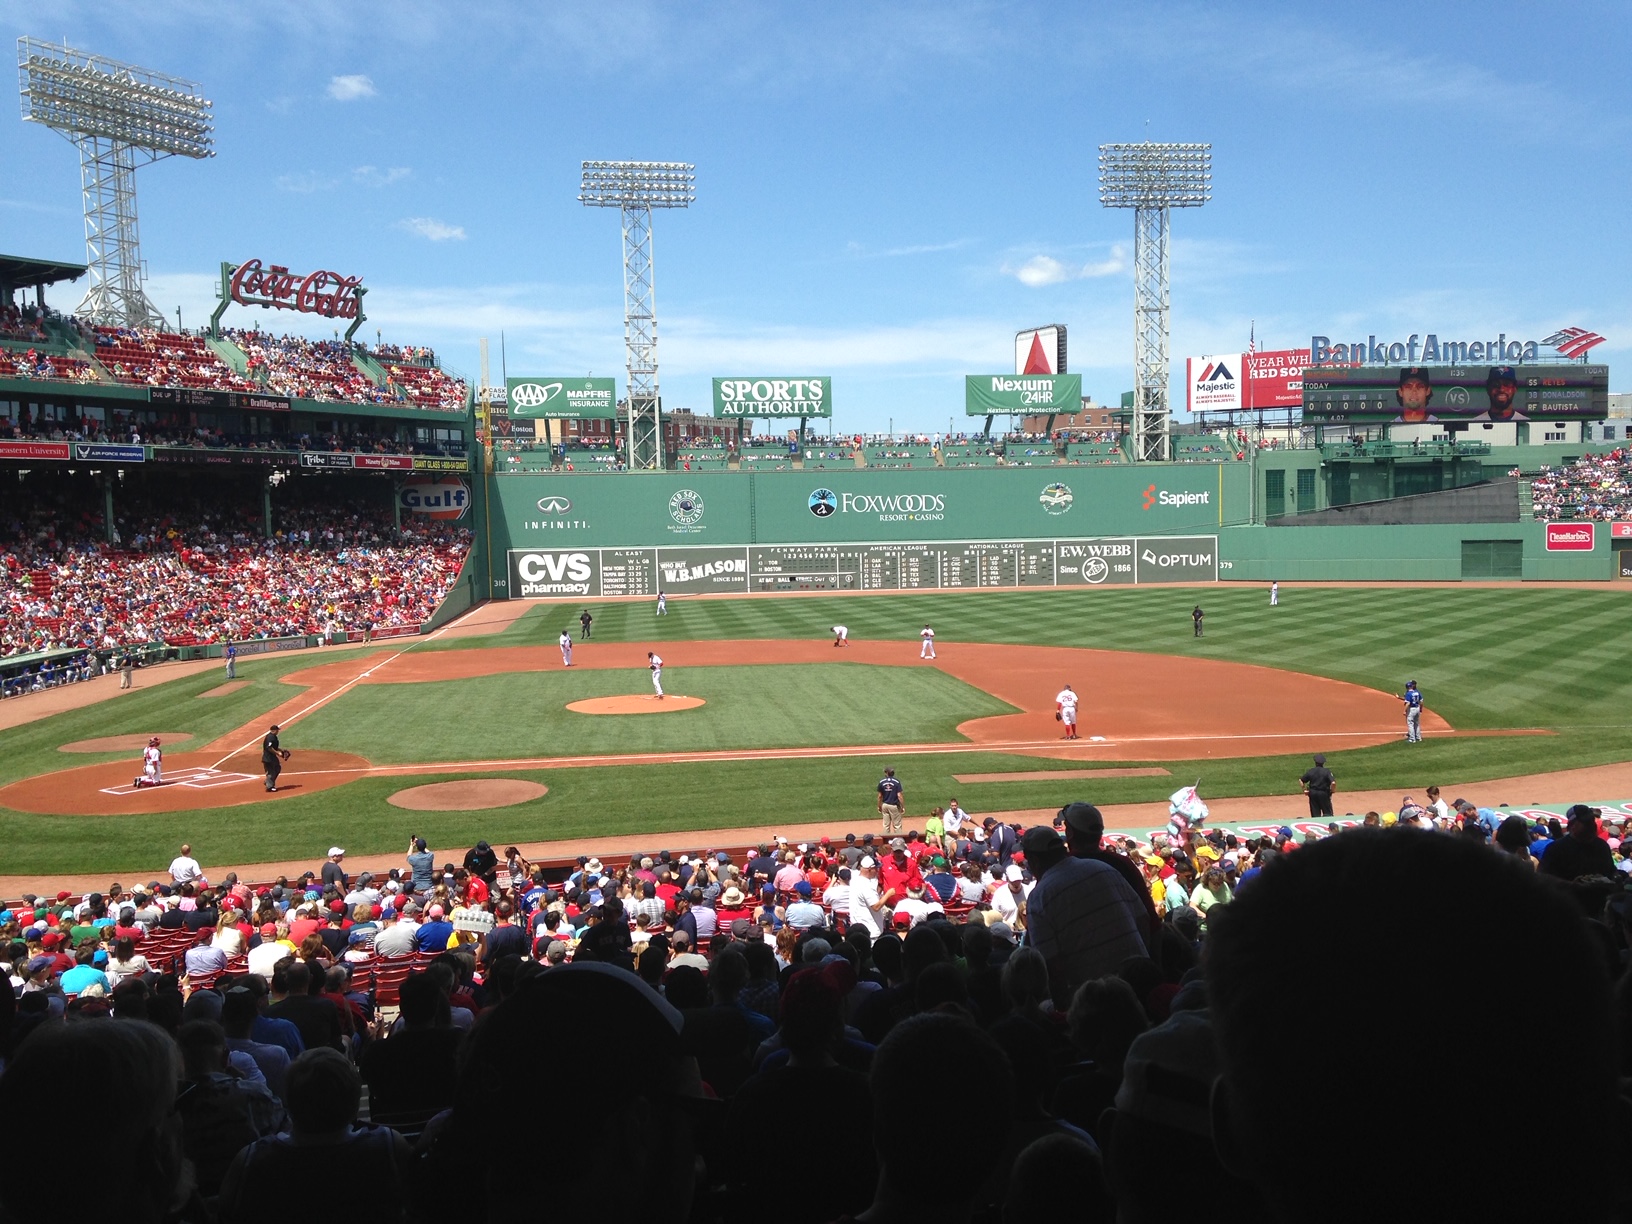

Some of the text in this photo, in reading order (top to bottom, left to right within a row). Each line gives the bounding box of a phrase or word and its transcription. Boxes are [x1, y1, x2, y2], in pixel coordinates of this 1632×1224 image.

[231, 258, 363, 319] Coca-Cola
[1311, 334, 1539, 363] Bank of America
[1247, 356, 1284, 369] WEAR
[1249, 368, 1278, 380] RED
[992, 377, 1053, 391] Nexium
[1197, 381, 1236, 394] Majestic
[1305, 382, 1329, 390] TODAY
[1543, 378, 1566, 386] REYES
[515, 385, 546, 406] AAA
[567, 390, 611, 399] MAPFRE
[720, 380, 824, 401] SPORTS
[1542, 391, 1586, 399] DONALDSON
[250, 398, 289, 410] DraftKings.com
[1450, 393, 1465, 405] VS
[722, 401, 823, 415] AUTHORITY
[1528, 403, 1579, 411] RF BAUTISTA
[30, 447, 66, 457] University
[304, 454, 326, 466] Tribe
[366, 457, 381, 466] Ninety
[415, 460, 427, 469] GIANT
[427, 460, 441, 469] GLASS
[400, 488, 465, 507] Gulf
[671, 491, 698, 507] RED SOX
[842, 493, 945, 513] FOXWOODS
[1159, 490, 1209, 508] Sapient
[914, 513, 944, 521] CASINO
[524, 520, 587, 530] INFINITI
[1060, 544, 1132, 557] F.W. WEBB
[1158, 553, 1212, 567] OPTUM
[1219, 561, 1233, 569] 379
[518, 553, 592, 582] CVS
[1060, 563, 1132, 574] Since 1866
[493, 579, 506, 588] 310
[521, 582, 590, 596] pharmacy
[276, 640, 302, 650] ShoreTel
